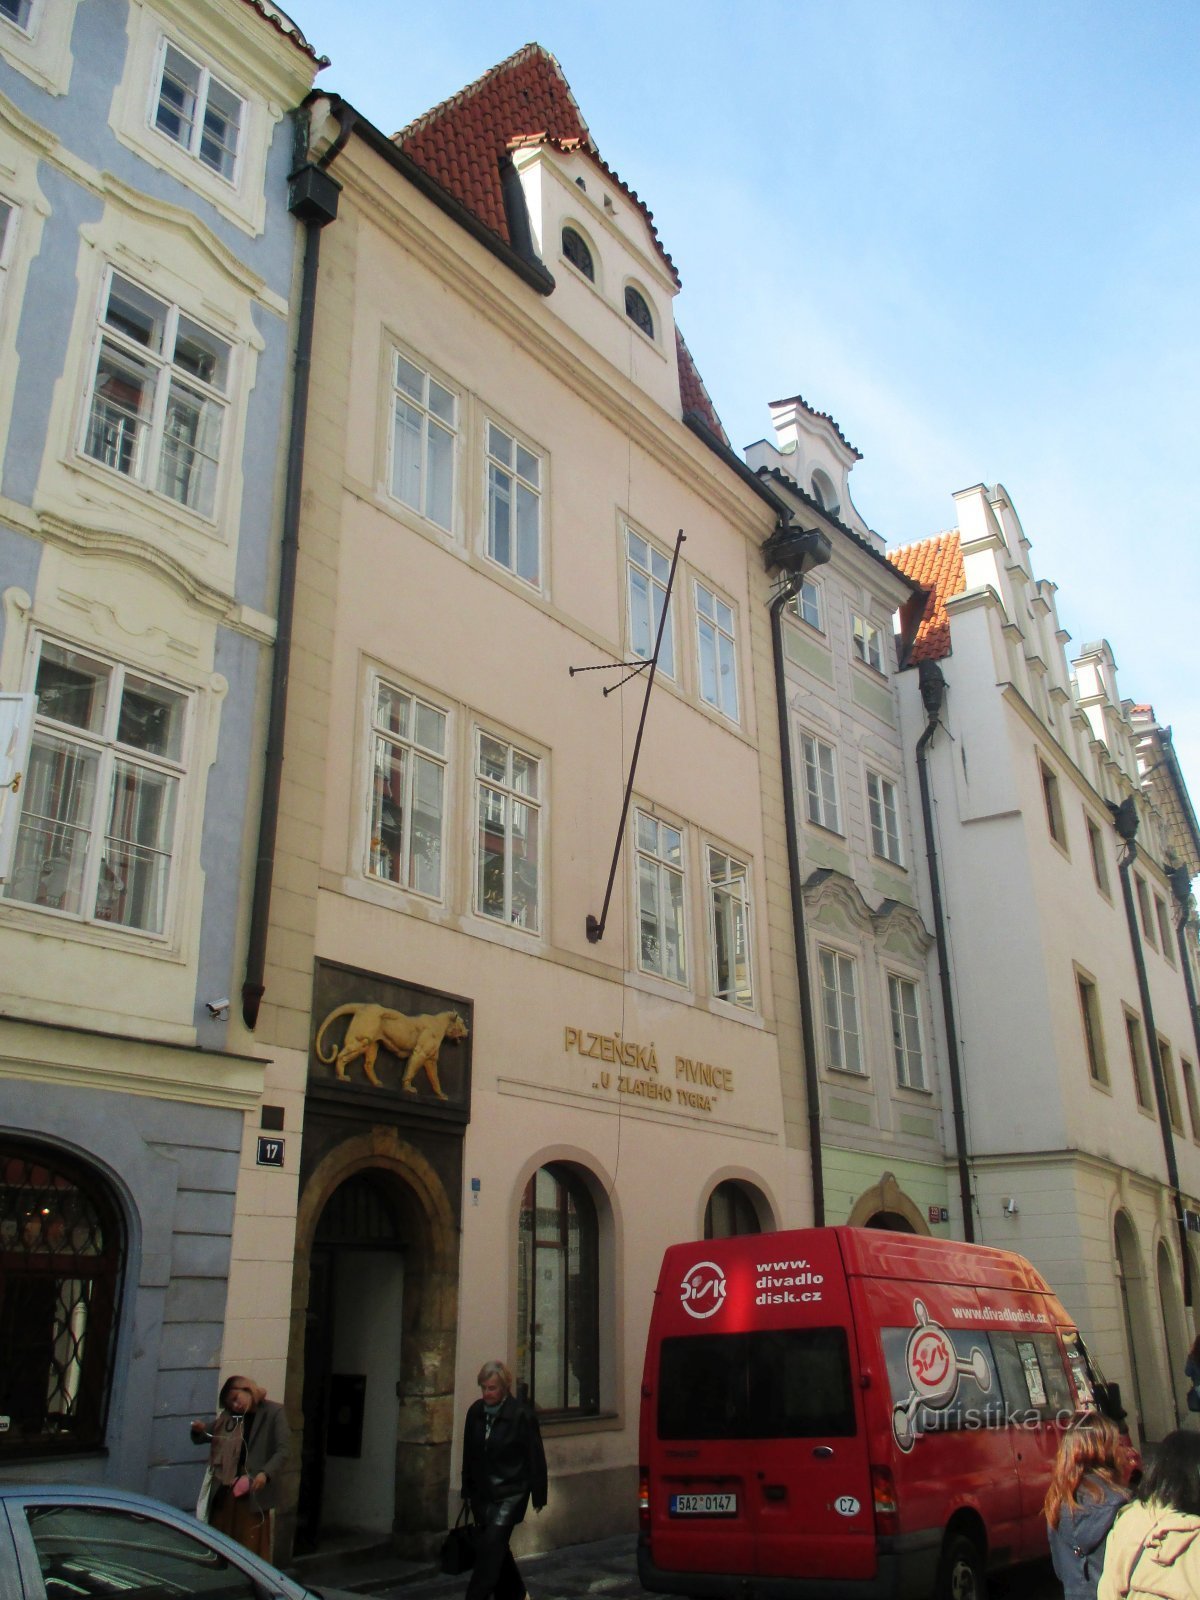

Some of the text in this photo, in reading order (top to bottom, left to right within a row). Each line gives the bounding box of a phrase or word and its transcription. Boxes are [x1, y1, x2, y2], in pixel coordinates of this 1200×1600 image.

[564, 1026, 734, 1092] PLZEŇSKÁ PIVNICE
[617, 1076, 672, 1102] ZLATÉHO
[266, 1143, 279, 1159] 17
[756, 1260, 811, 1273] www.
[756, 1273, 824, 1289] divadlo
[755, 1291, 823, 1306] disk.cz
[952, 1306, 1048, 1324] www.divadlodisk.cz
[678, 1496, 732, 1511] 5A2 0147
[839, 1498, 856, 1513] CZ
